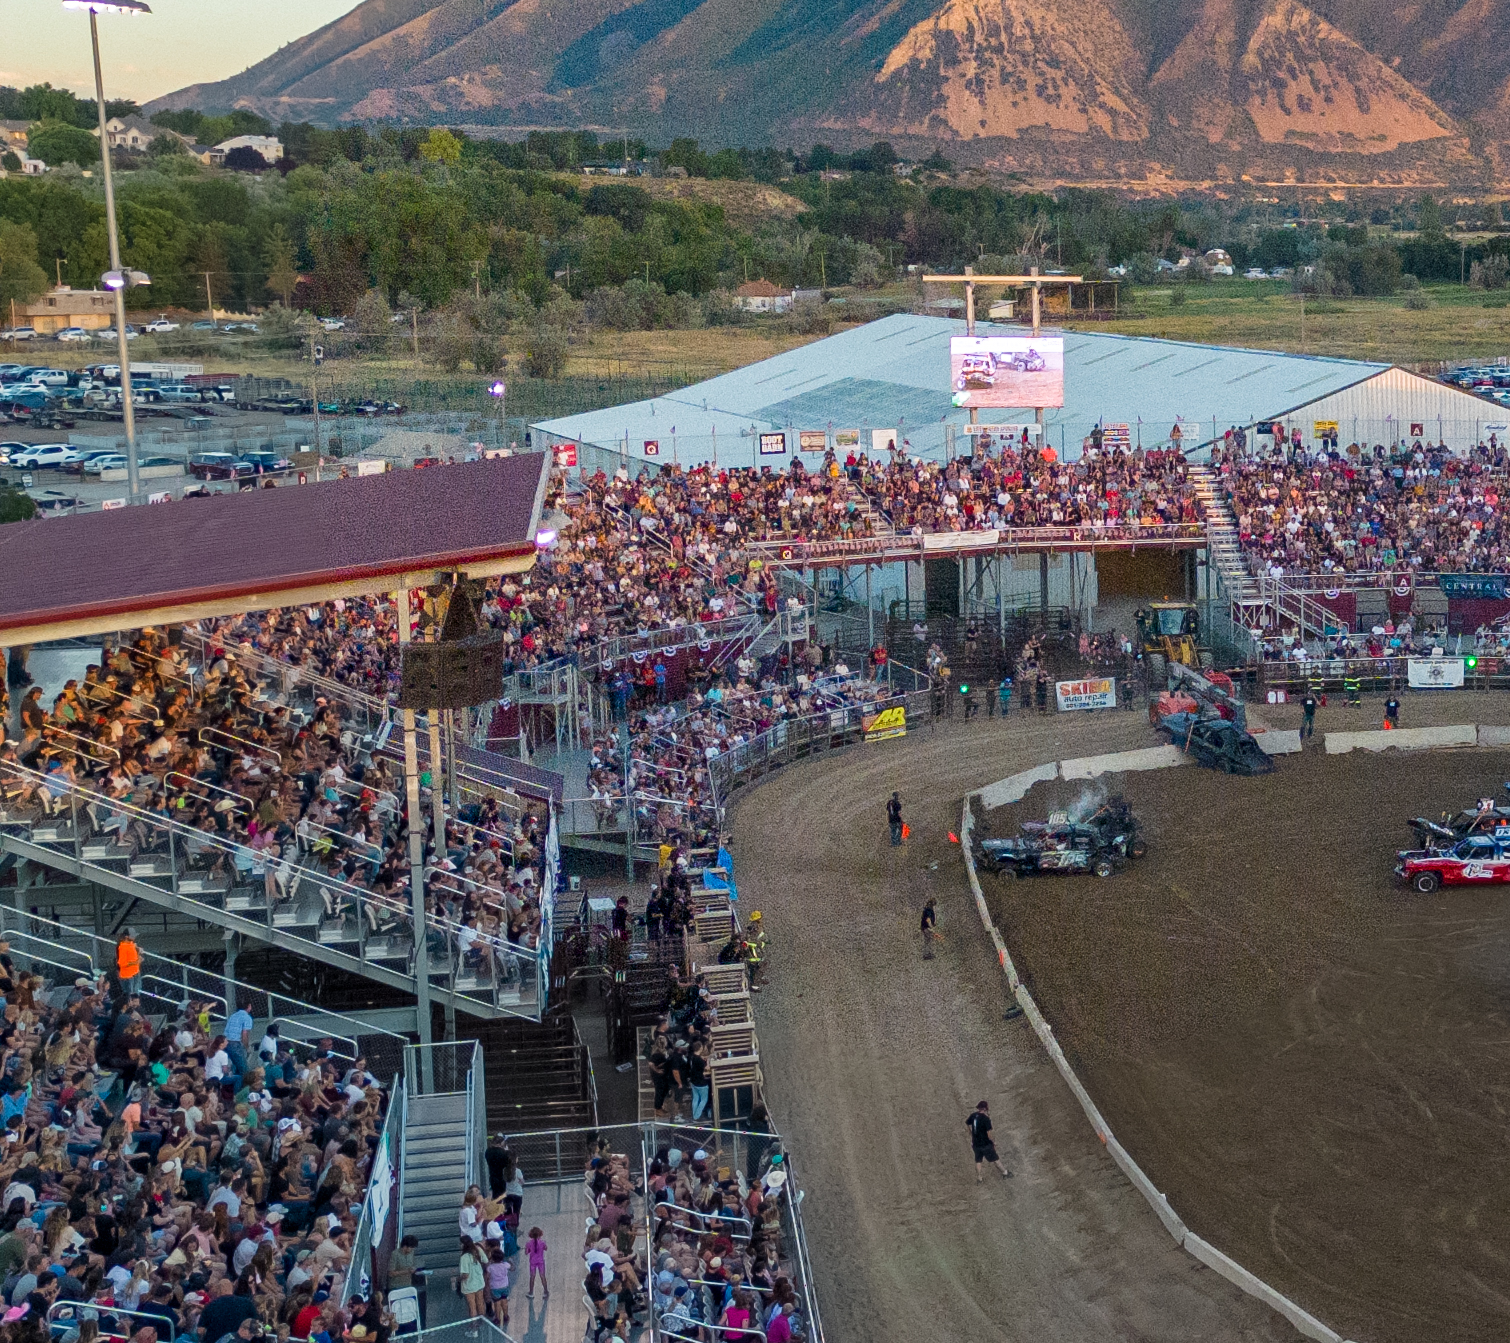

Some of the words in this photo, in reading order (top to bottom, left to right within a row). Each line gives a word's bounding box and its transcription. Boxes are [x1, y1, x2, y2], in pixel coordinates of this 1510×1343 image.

[1413, 427, 1421, 436] A
[1399, 577, 1407, 587] A
[1445, 582, 1498, 590] CENTRAL
[1064, 694, 1083, 702] auto
[1085, 692, 1108, 701] repair
[1049, 813, 1067, 825] 105
